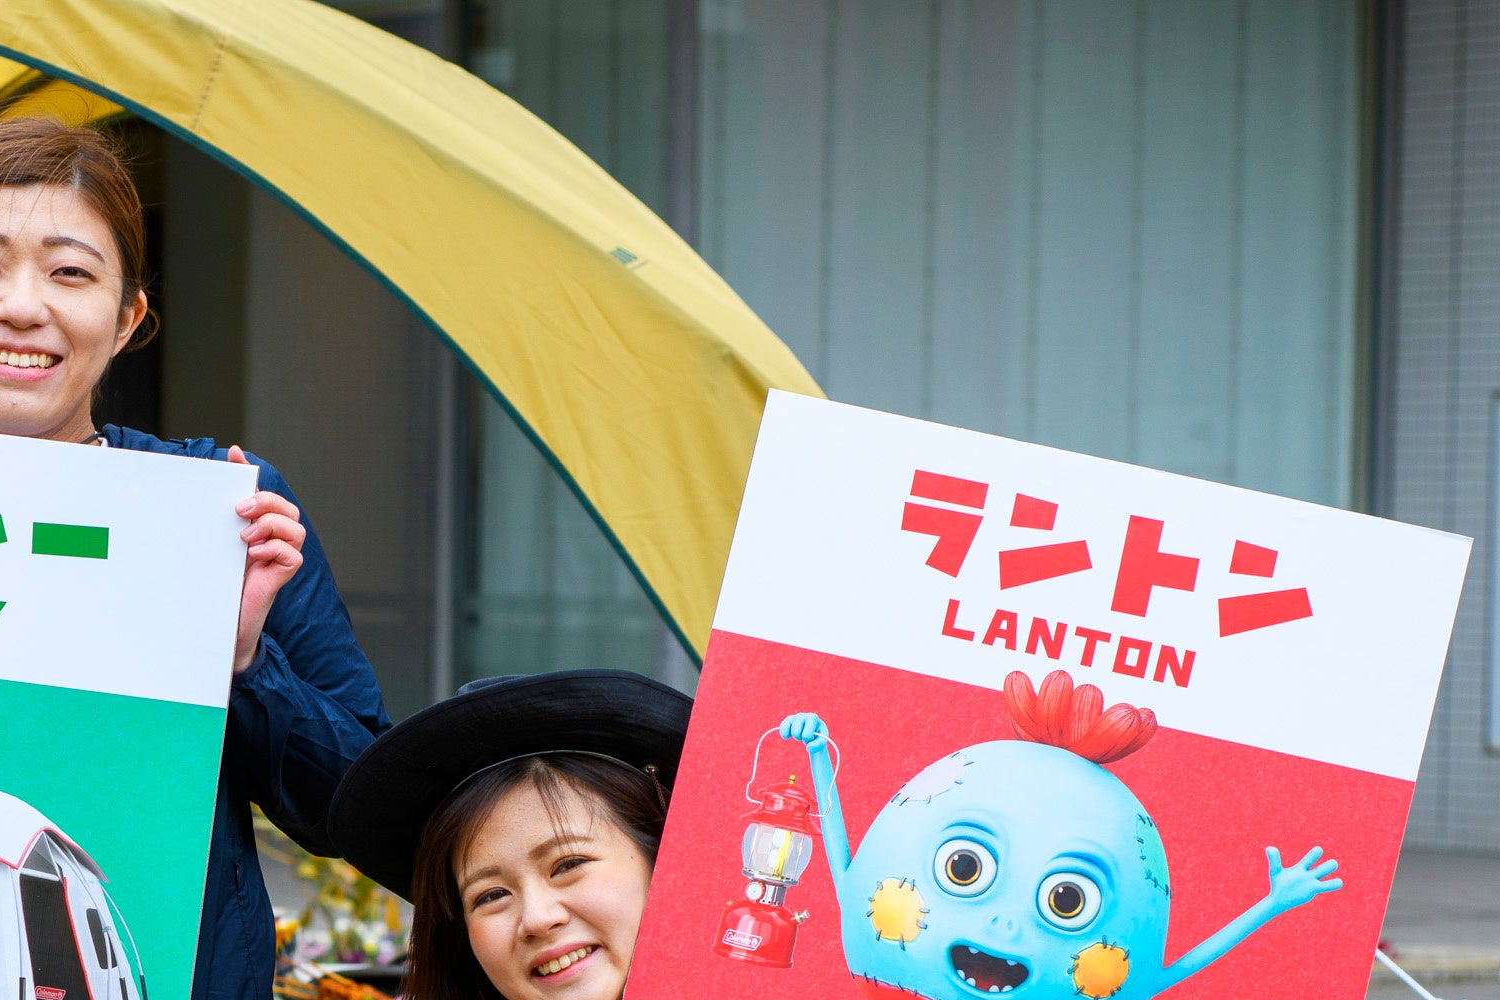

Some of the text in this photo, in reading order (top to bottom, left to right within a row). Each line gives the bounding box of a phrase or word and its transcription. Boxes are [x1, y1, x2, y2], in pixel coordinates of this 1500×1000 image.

[901, 469, 1314, 638] ラントン
[941, 598, 1197, 688] LANTON
